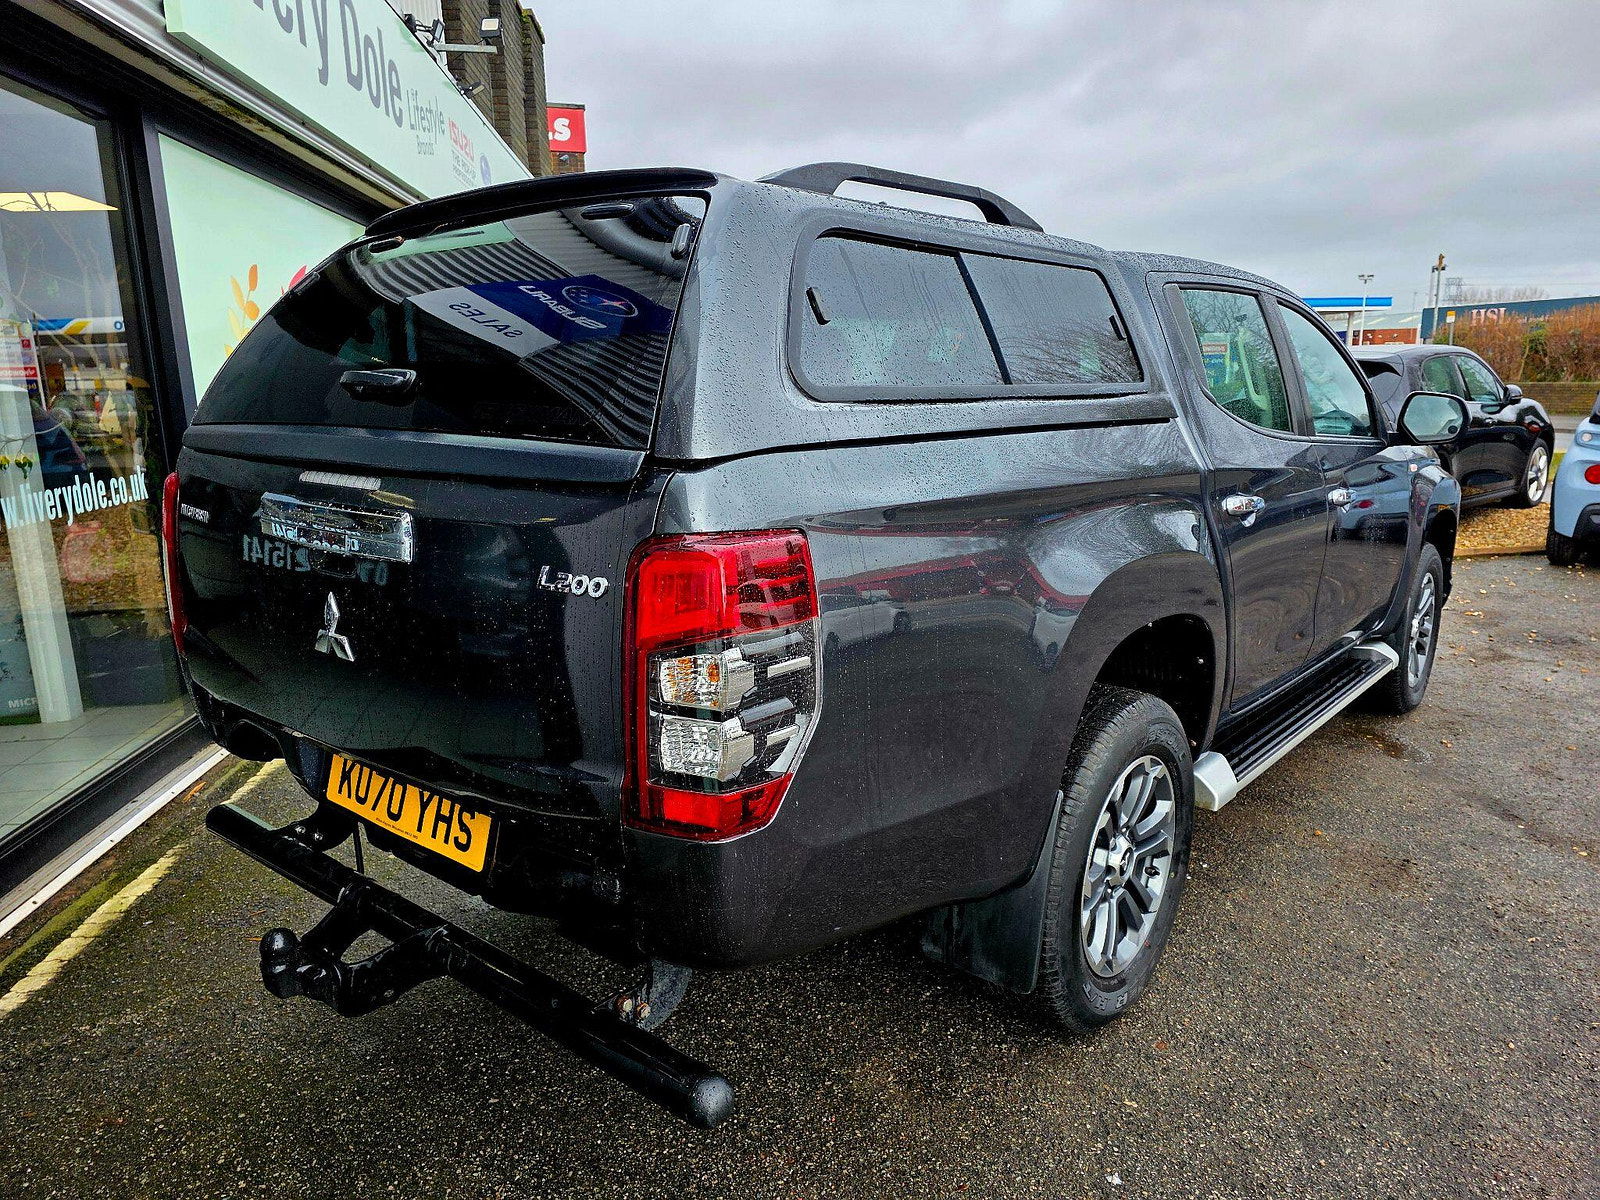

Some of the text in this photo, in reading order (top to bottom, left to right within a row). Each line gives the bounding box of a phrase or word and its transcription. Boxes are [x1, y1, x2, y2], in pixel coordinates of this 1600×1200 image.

[340, 0, 403, 128] Dole
[407, 88, 445, 145] Lifestyle
[548, 117, 571, 141] S
[538, 565, 608, 598] L200
[338, 757, 478, 853] KU70 YHS
